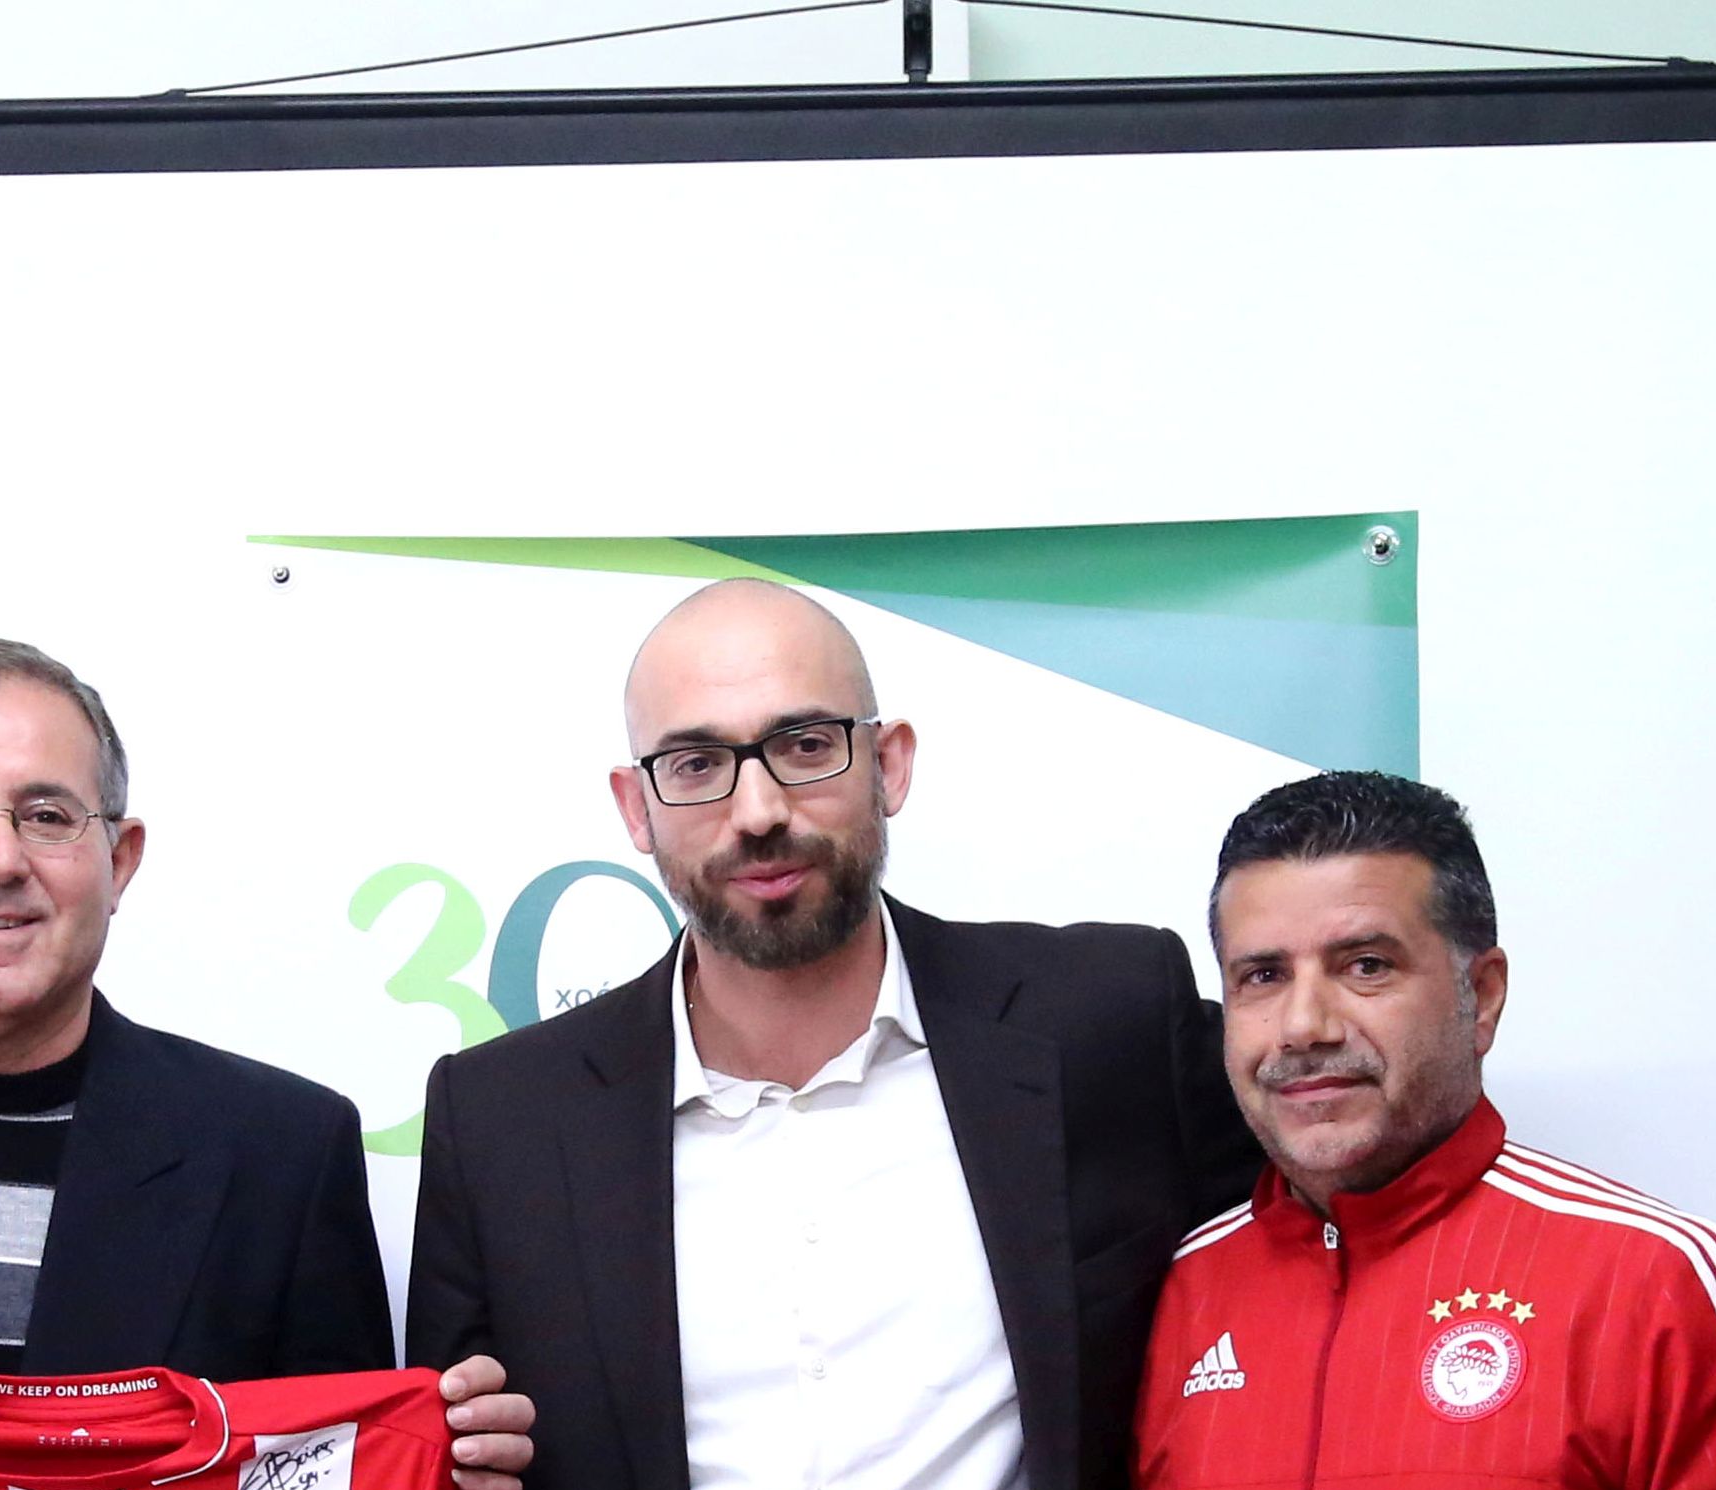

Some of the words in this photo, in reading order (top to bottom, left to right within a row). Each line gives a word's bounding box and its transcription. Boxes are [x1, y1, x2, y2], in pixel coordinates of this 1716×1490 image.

[18, 1384, 51, 1397] KEEP
[55, 1385, 78, 1397] ON
[82, 1377, 158, 1396] DREAMING
[1183, 1370, 1246, 1398] adidas
